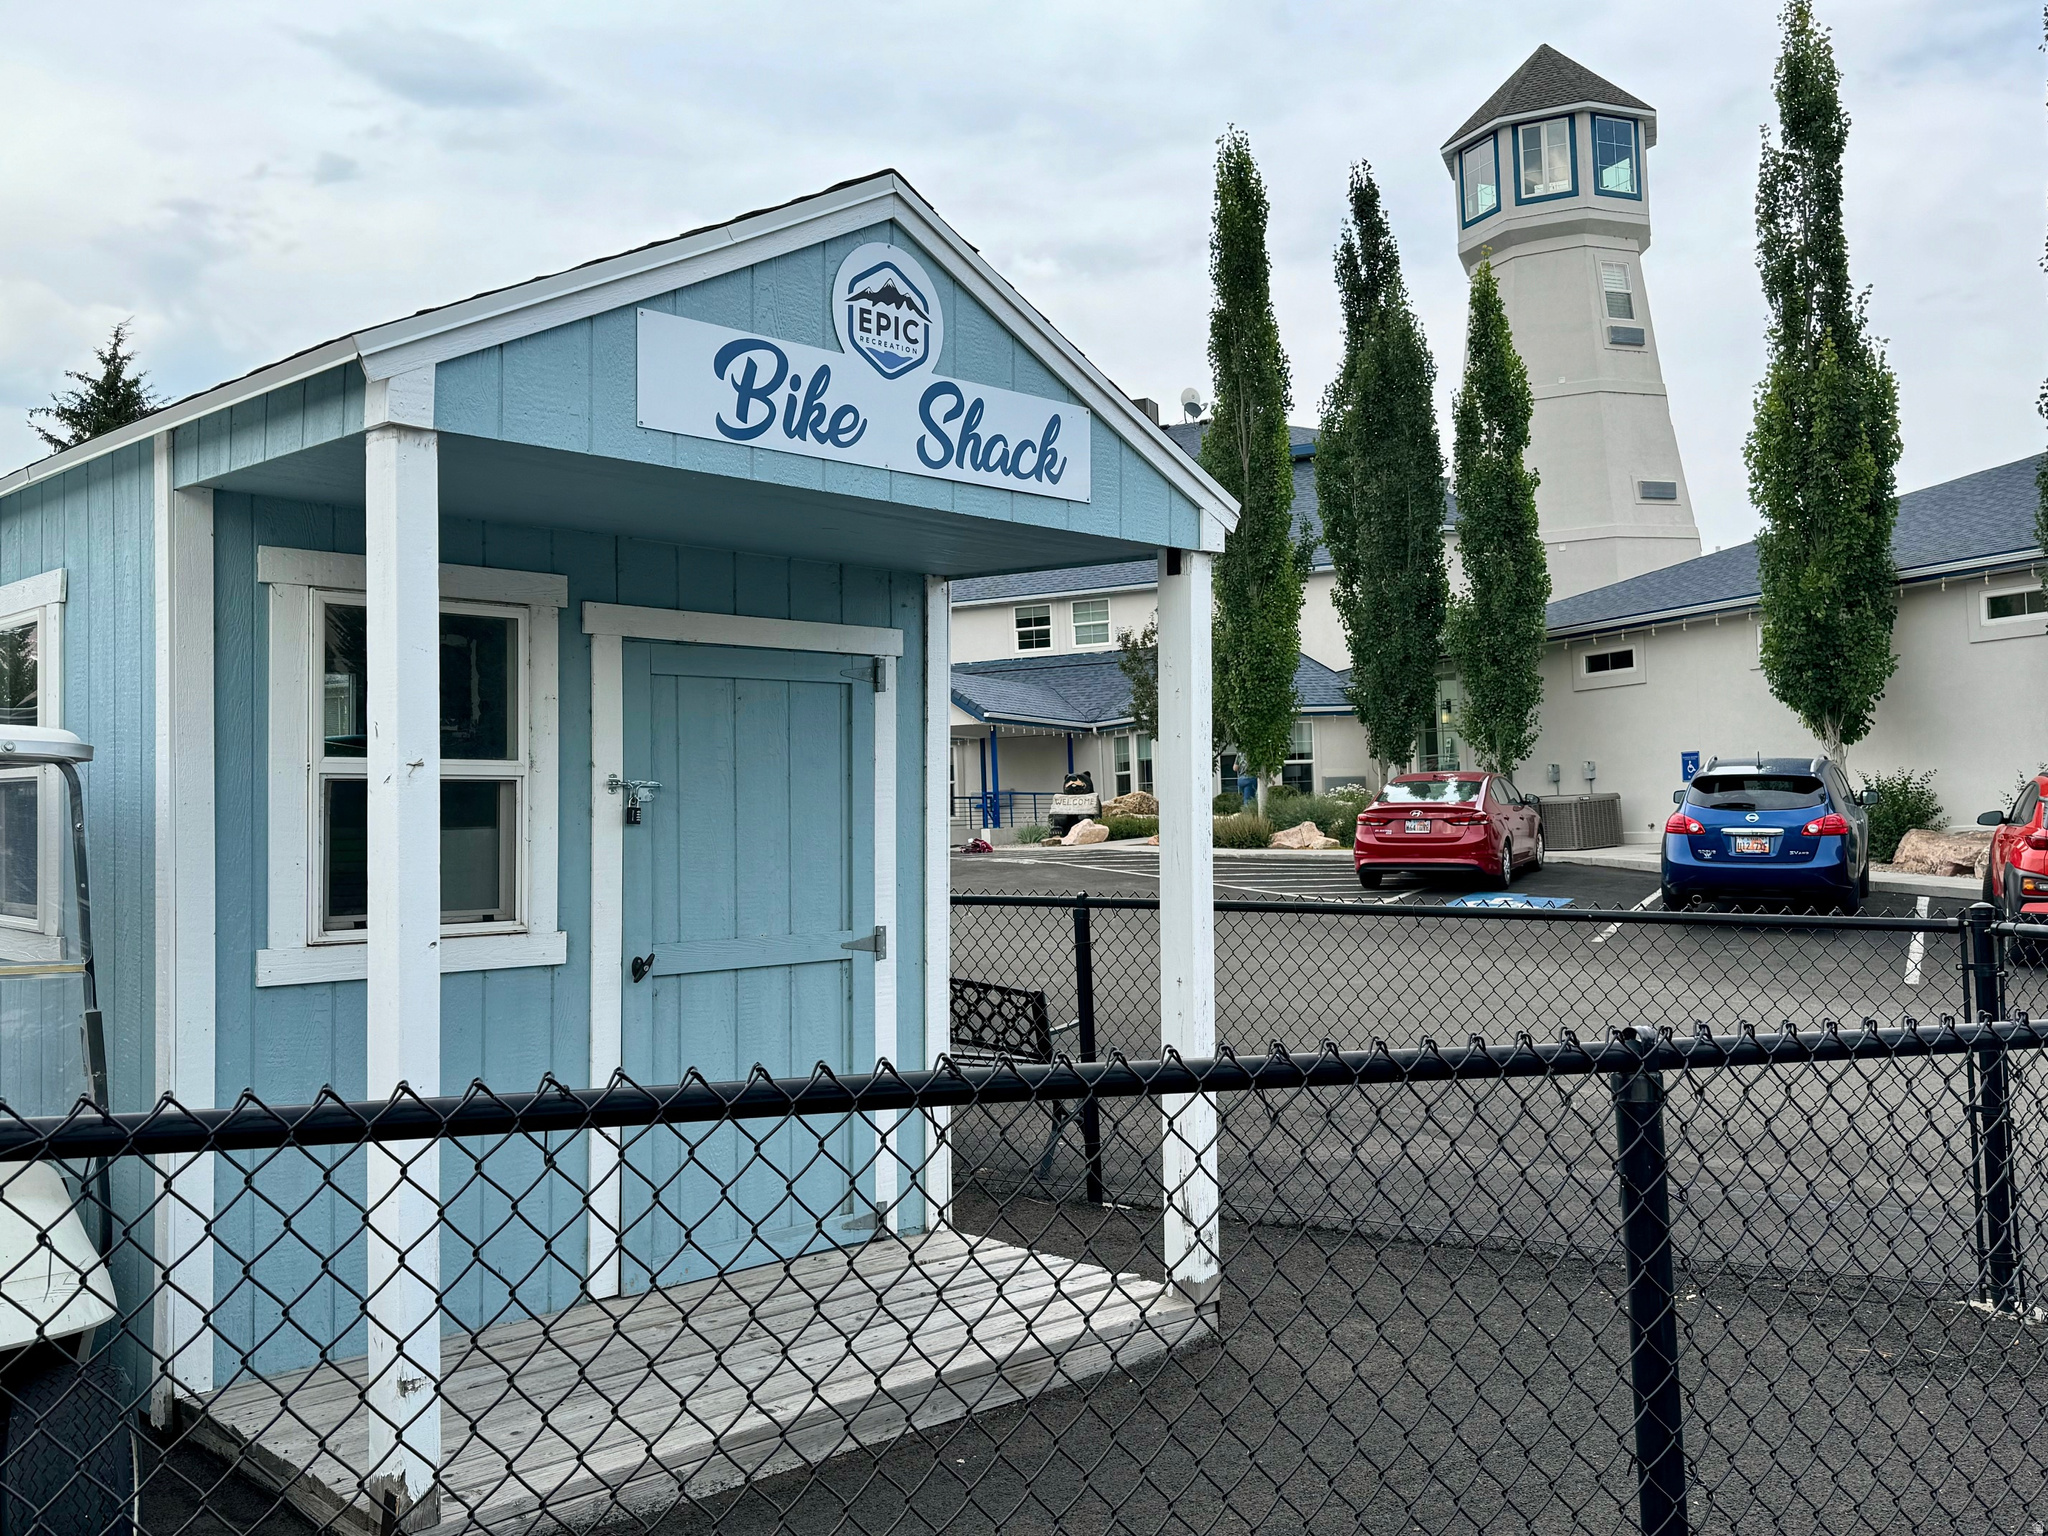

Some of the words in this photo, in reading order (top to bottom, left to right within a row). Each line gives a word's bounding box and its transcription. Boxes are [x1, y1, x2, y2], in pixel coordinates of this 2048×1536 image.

[859, 306, 920, 345] EPIC
[859, 335, 918, 355] RECREATION
[714, 339, 867, 448] Bike
[917, 382, 1067, 485] Shack
[1054, 798, 1095, 806] WELCOME
